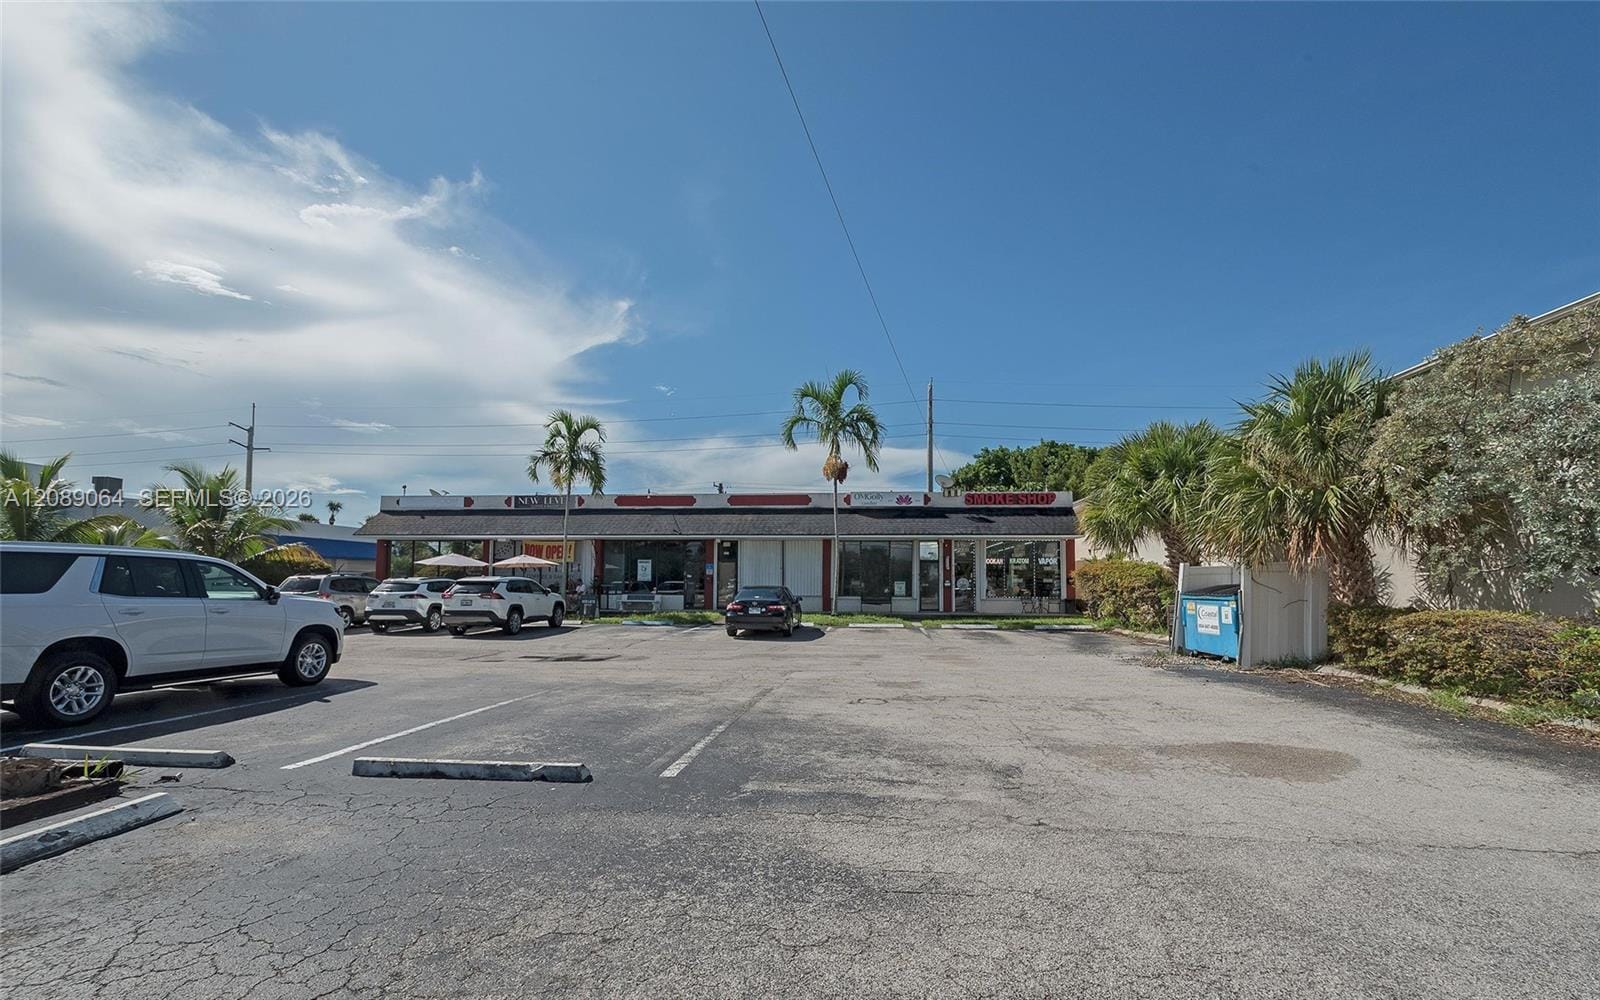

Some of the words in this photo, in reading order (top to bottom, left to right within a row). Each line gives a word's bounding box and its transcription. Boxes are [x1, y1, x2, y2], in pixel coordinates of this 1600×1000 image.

[519, 497, 538, 505] NEW
[544, 497, 567, 505] LEVE
[965, 493, 1014, 505] SMOKE
[1018, 493, 1056, 505] SHOP
[524, 543, 544, 559] NOW
